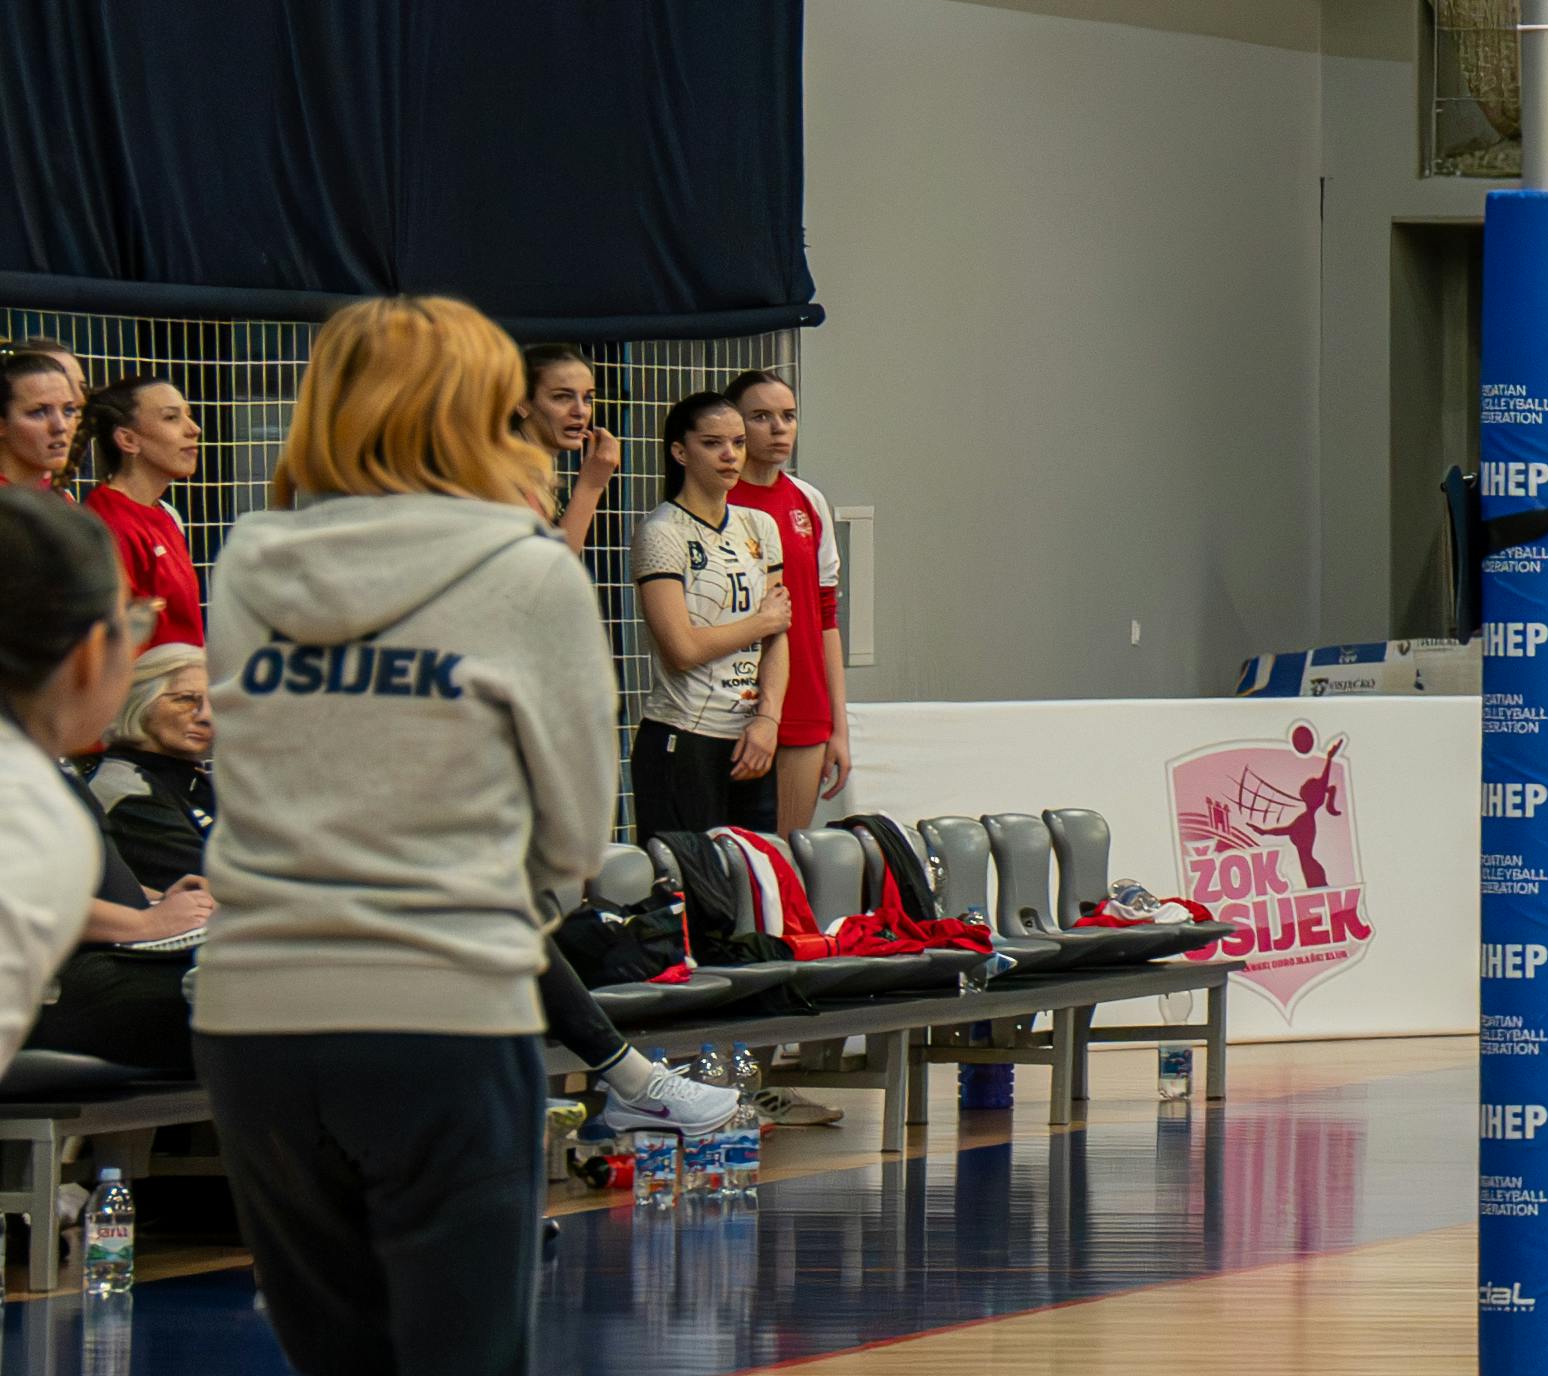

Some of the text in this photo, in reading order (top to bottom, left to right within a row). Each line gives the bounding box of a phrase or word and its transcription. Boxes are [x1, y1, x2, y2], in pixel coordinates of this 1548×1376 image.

[727, 571, 751, 613] 15
[241, 644, 465, 700] OSIJEK
[1483, 707, 1548, 720] OLLEYBALL
[1189, 844, 1290, 904] ŽOK
[1481, 867, 1548, 881] OLLEYBALL
[1481, 1028, 1548, 1042] OLLEYBALL
[1481, 1189, 1548, 1203] OLLEYBALL
